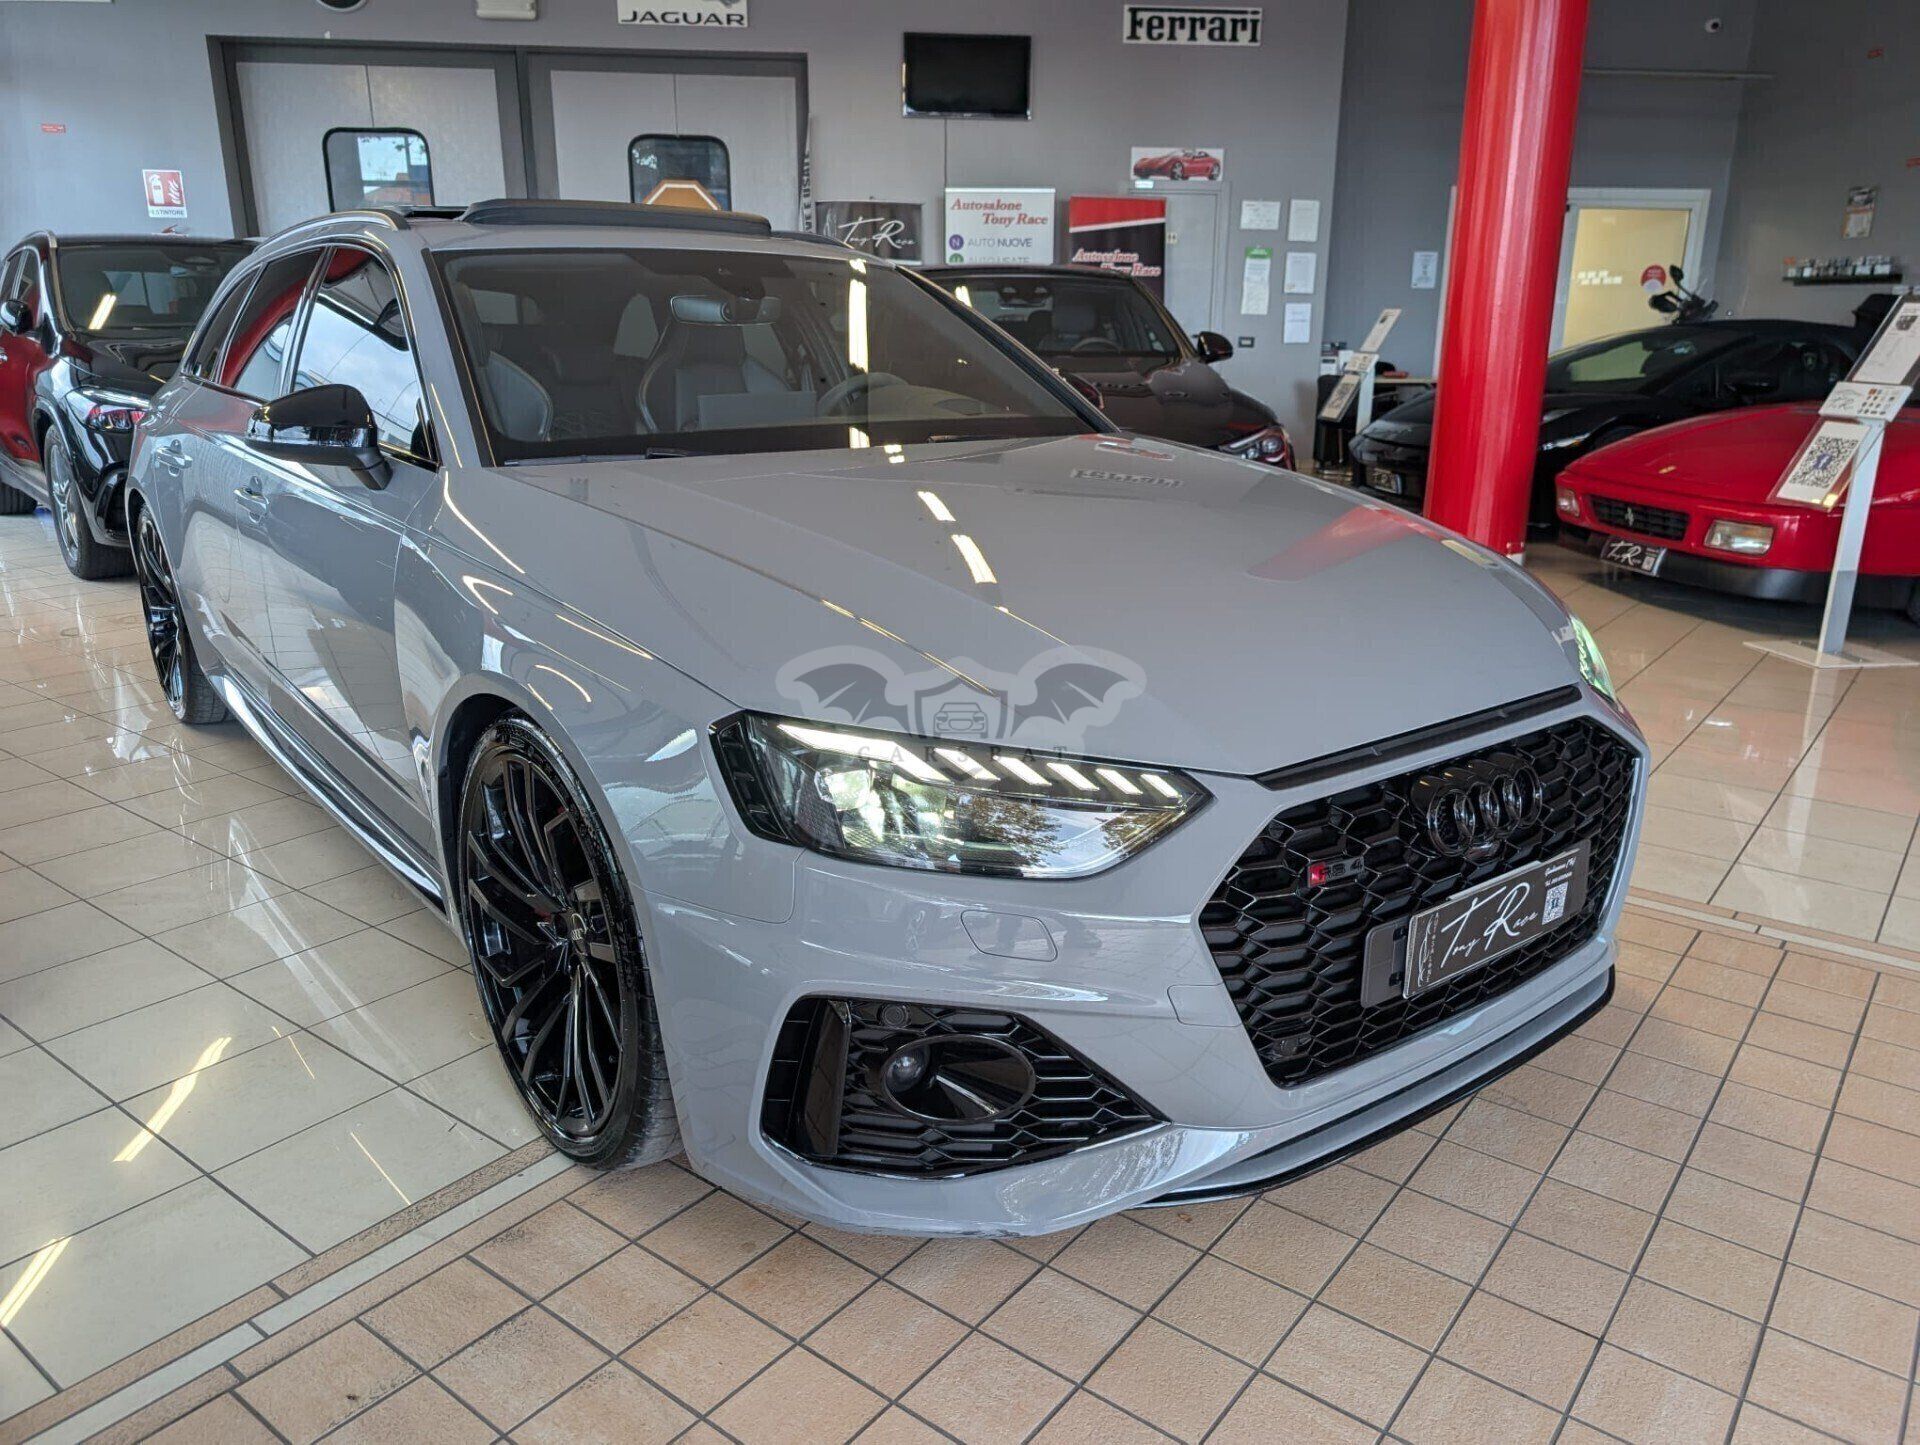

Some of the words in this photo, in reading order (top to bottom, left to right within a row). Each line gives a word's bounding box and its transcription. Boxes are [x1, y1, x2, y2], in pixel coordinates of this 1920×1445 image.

[620, 10, 745, 26] JAGUAR
[1126, 7, 1260, 43] Ferrari
[951, 198, 1022, 210] Autosalone
[983, 213, 1014, 228] Tony
[1016, 213, 1048, 225] Race
[968, 238, 995, 247] AUTO
[997, 238, 1032, 248] NUOVE
[1441, 886, 1507, 968] Tony
[1483, 882, 1538, 951] Race
